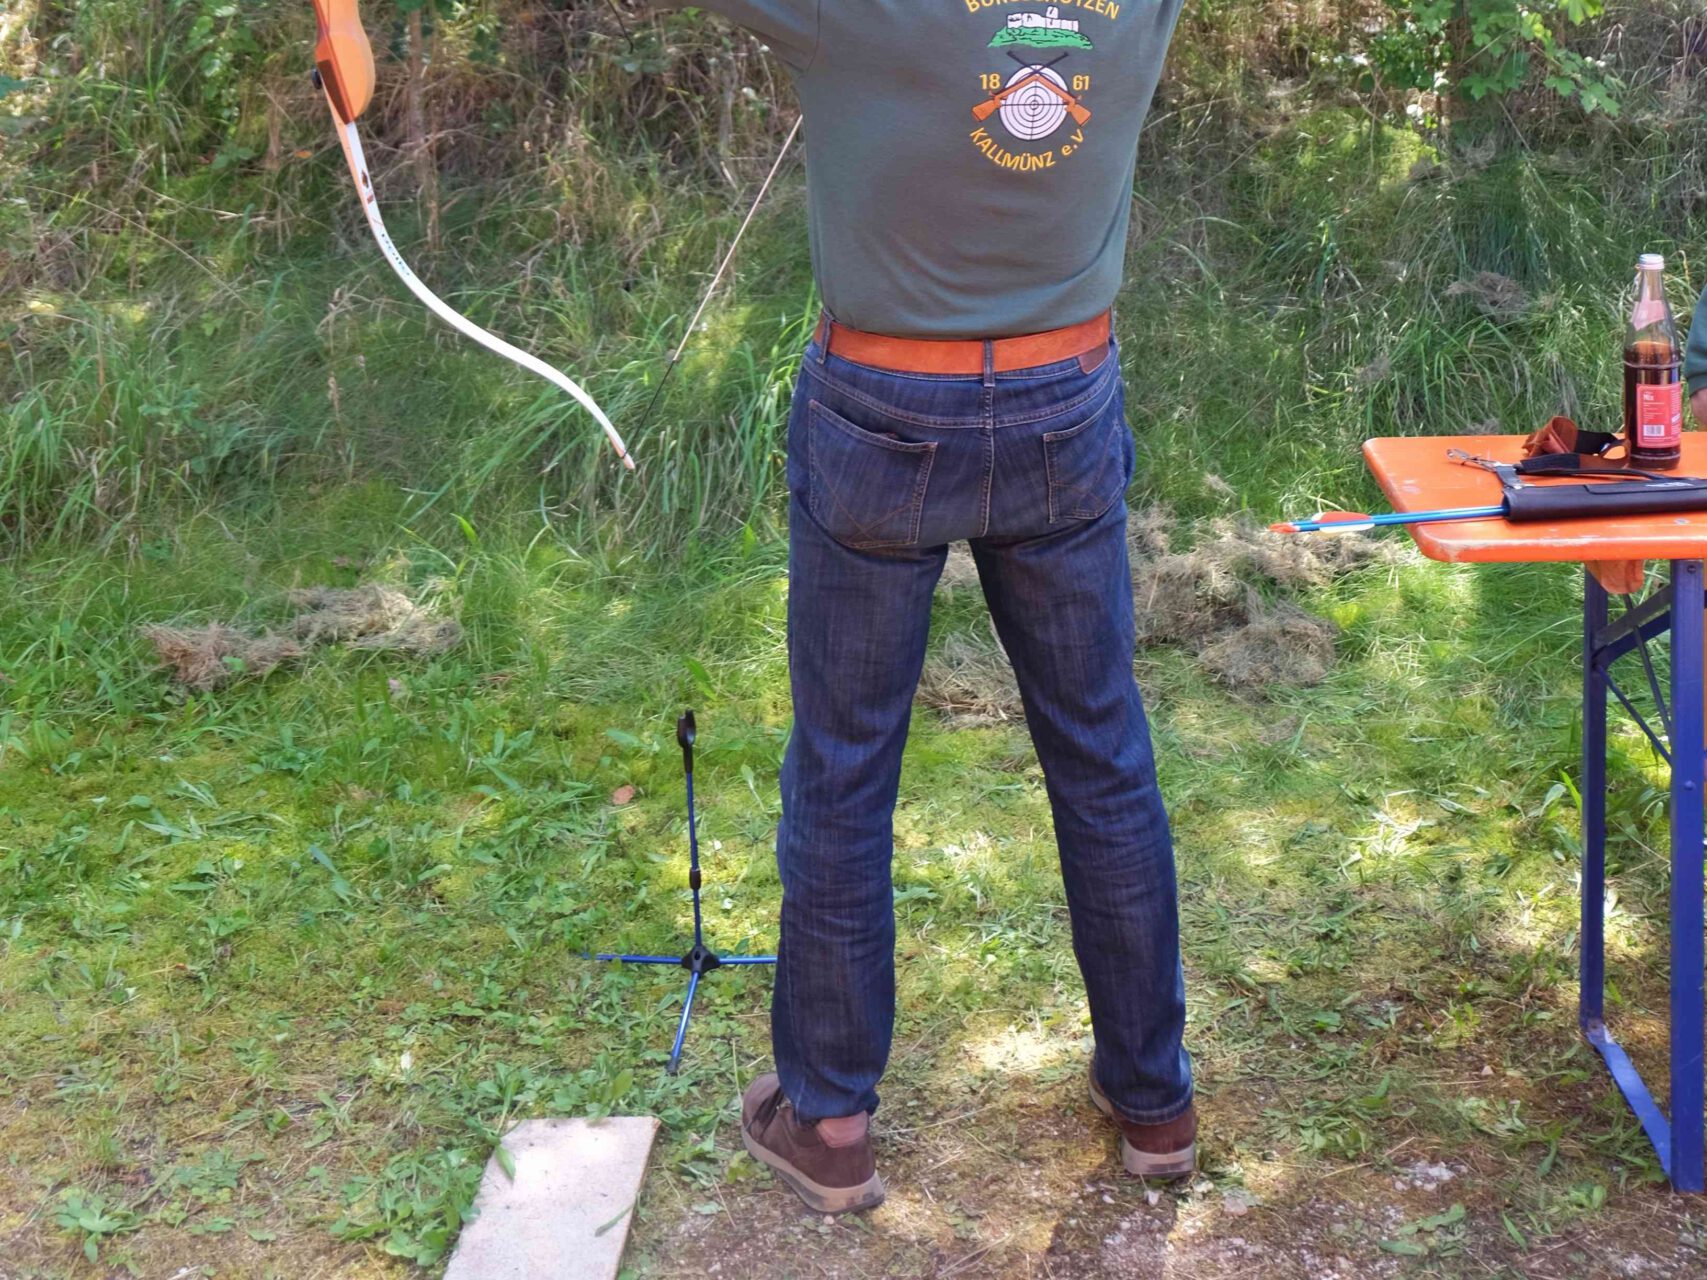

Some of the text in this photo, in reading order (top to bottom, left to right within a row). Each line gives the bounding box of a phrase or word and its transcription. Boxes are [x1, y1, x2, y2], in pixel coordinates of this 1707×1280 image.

[979, 73, 1090, 90] 18 61
[970, 127, 1056, 171] KALLMÜNZ
